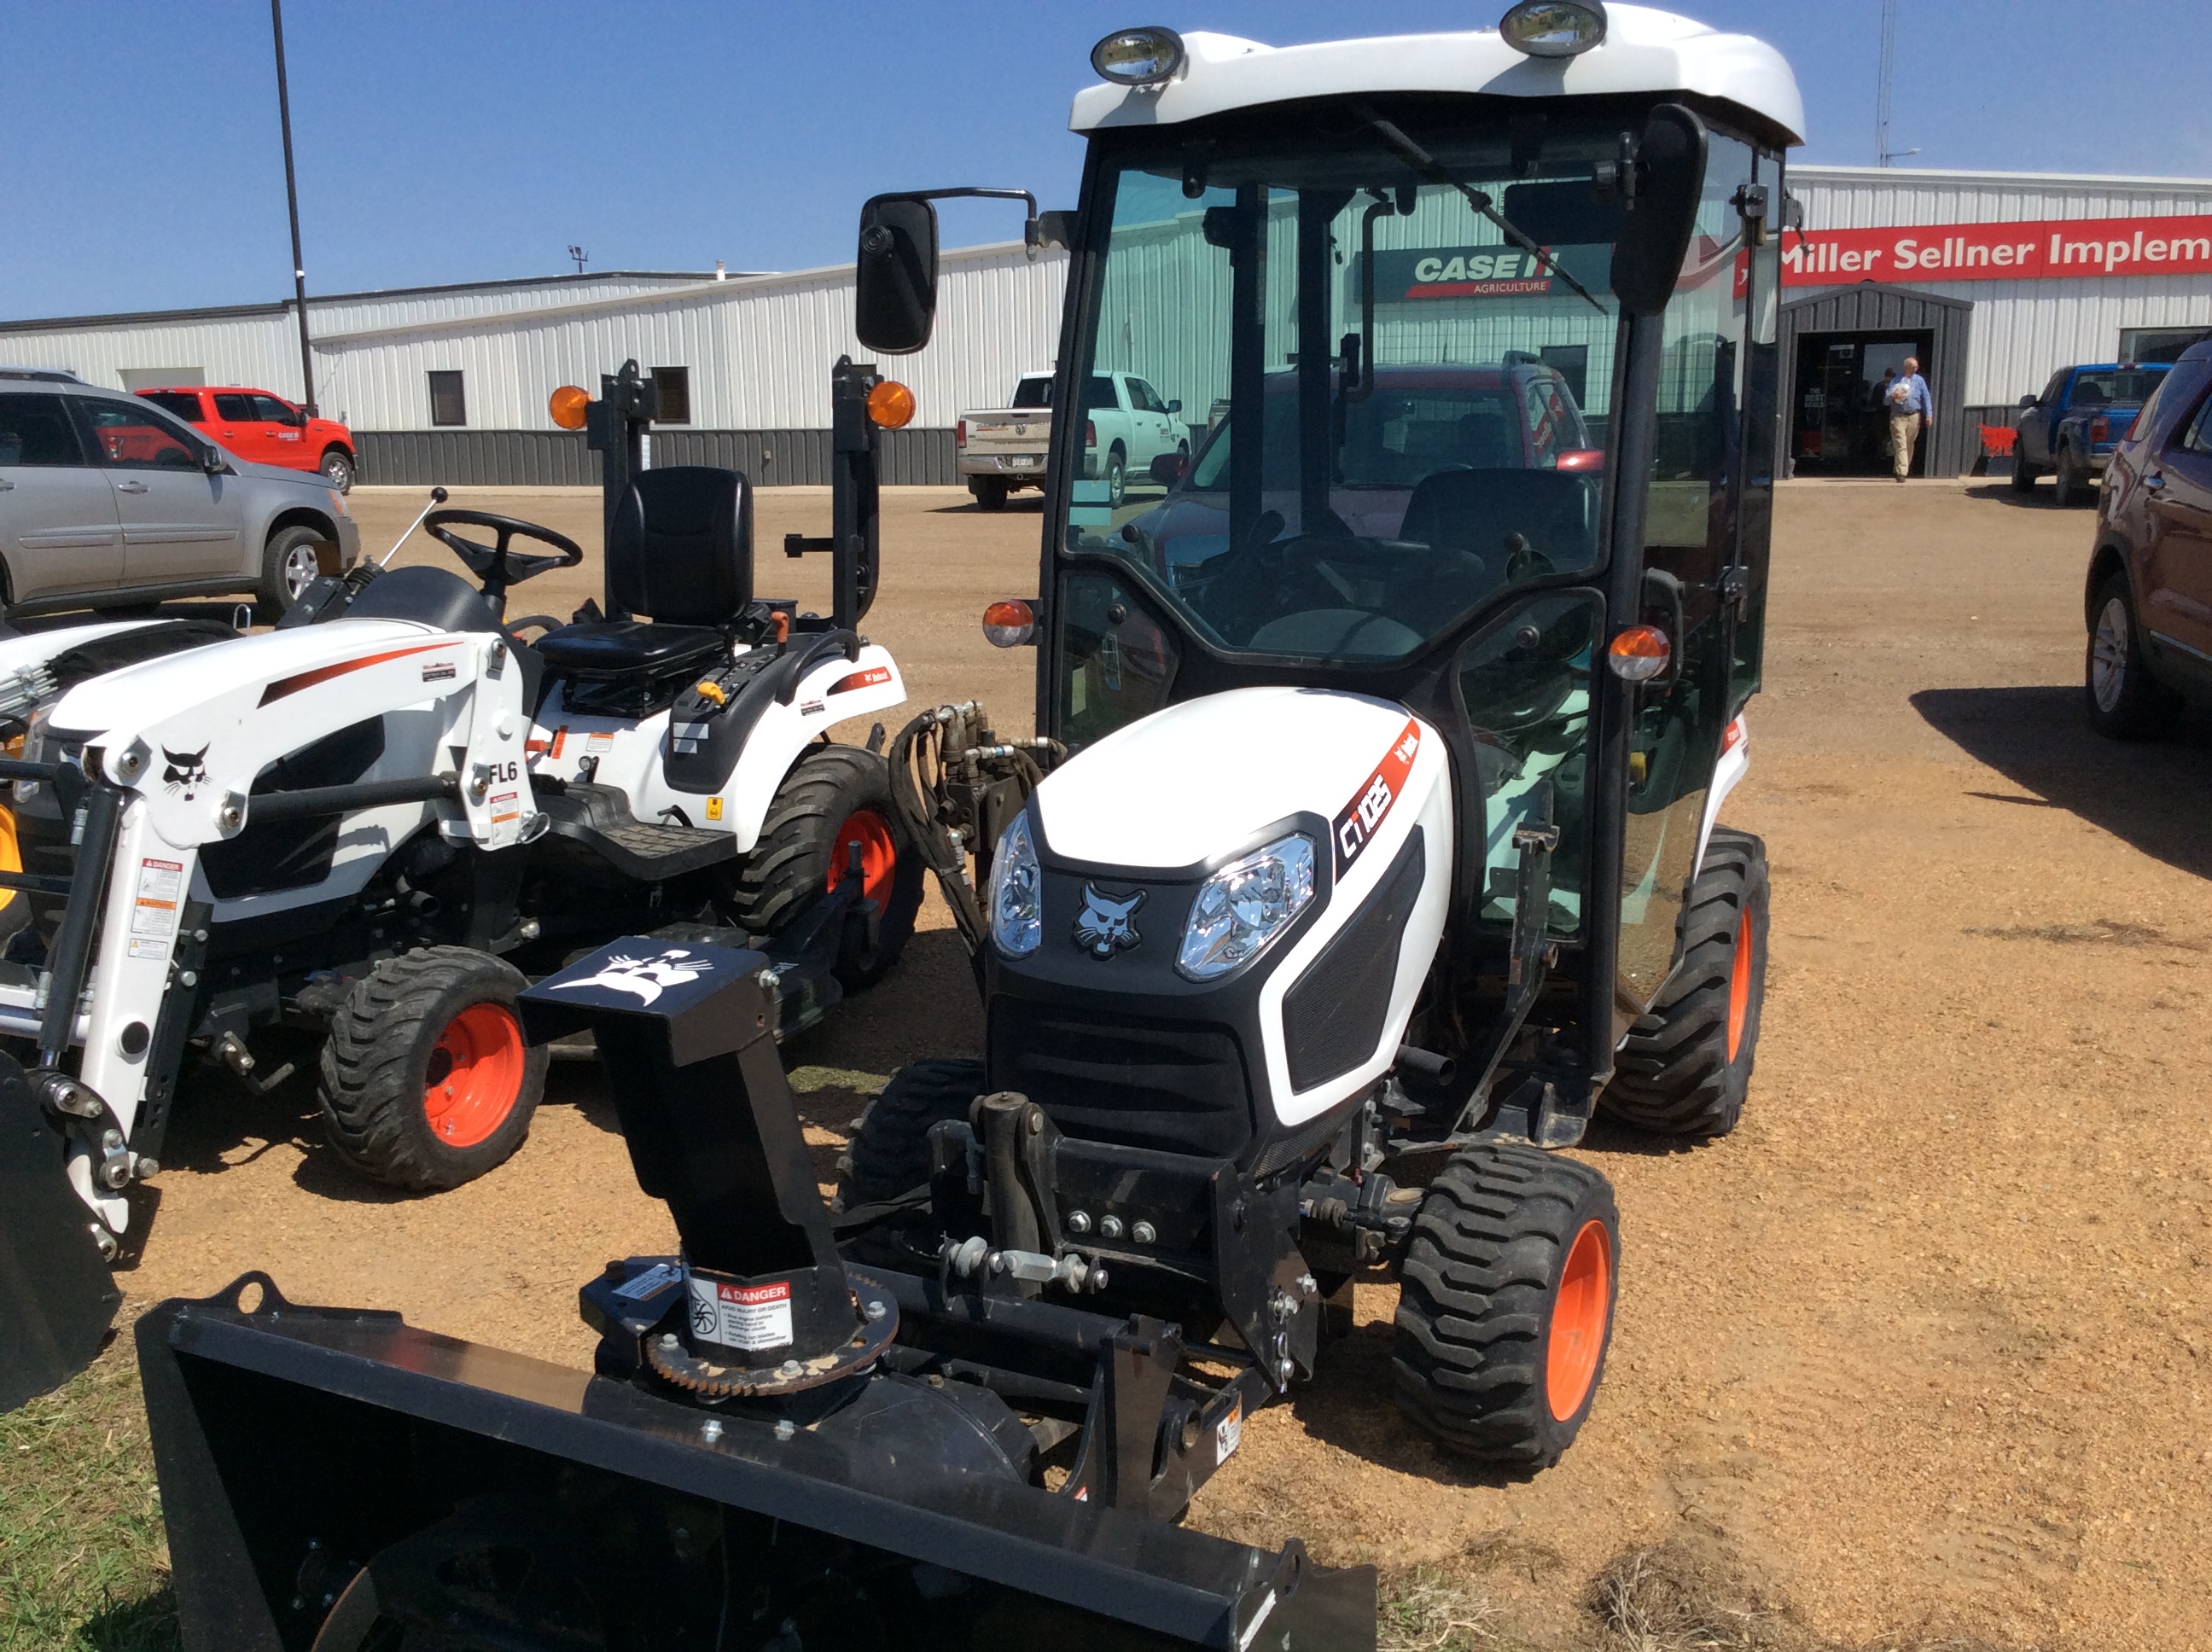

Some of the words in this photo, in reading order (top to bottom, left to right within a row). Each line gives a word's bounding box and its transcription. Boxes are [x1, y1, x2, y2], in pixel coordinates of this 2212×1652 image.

[1894, 237, 2036, 270] Sellner
[2049, 230, 2210, 272] Implem
[1415, 254, 1522, 282] CASE
[1474, 281, 1547, 294] AGRICULTURE
[489, 761, 517, 785] FL6
[153, 861, 180, 870] DANGER
[733, 1286, 786, 1302] DANGER
